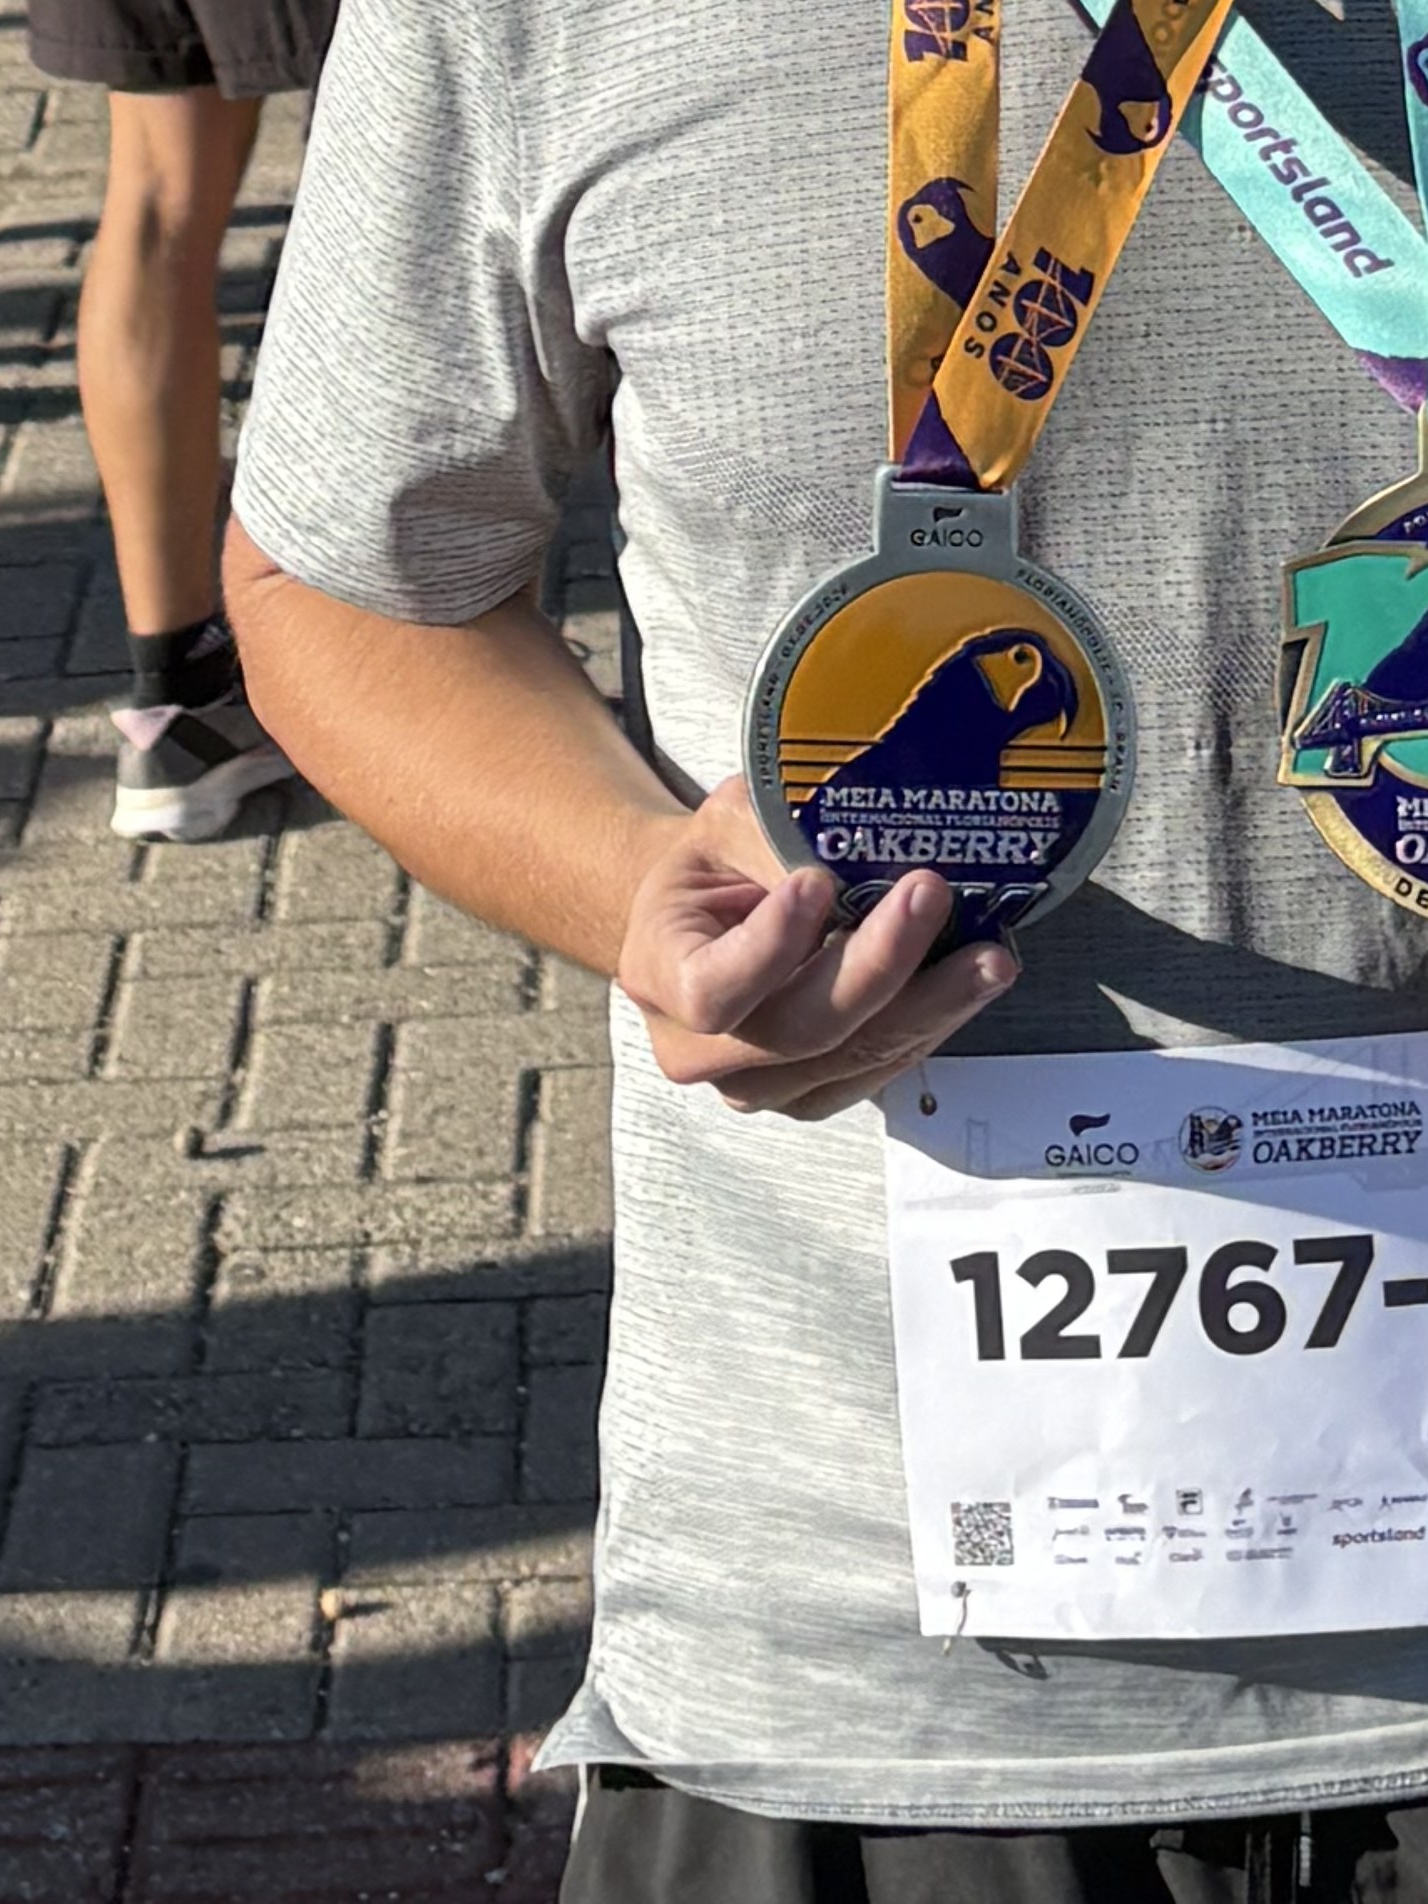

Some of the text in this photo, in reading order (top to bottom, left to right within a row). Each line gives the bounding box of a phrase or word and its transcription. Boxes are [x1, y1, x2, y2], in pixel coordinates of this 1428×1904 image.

[964, 250, 1019, 360] ANOS
[909, 528, 983, 548] GAICO
[820, 786, 1061, 813] MEIA MARATONA
[817, 826, 1062, 865] OAKBERRY
[1251, 1100, 1422, 1126] MEIA MARATONA
[1044, 1142, 1140, 1167] GAICO
[1252, 1130, 1423, 1165] OAKBERRY
